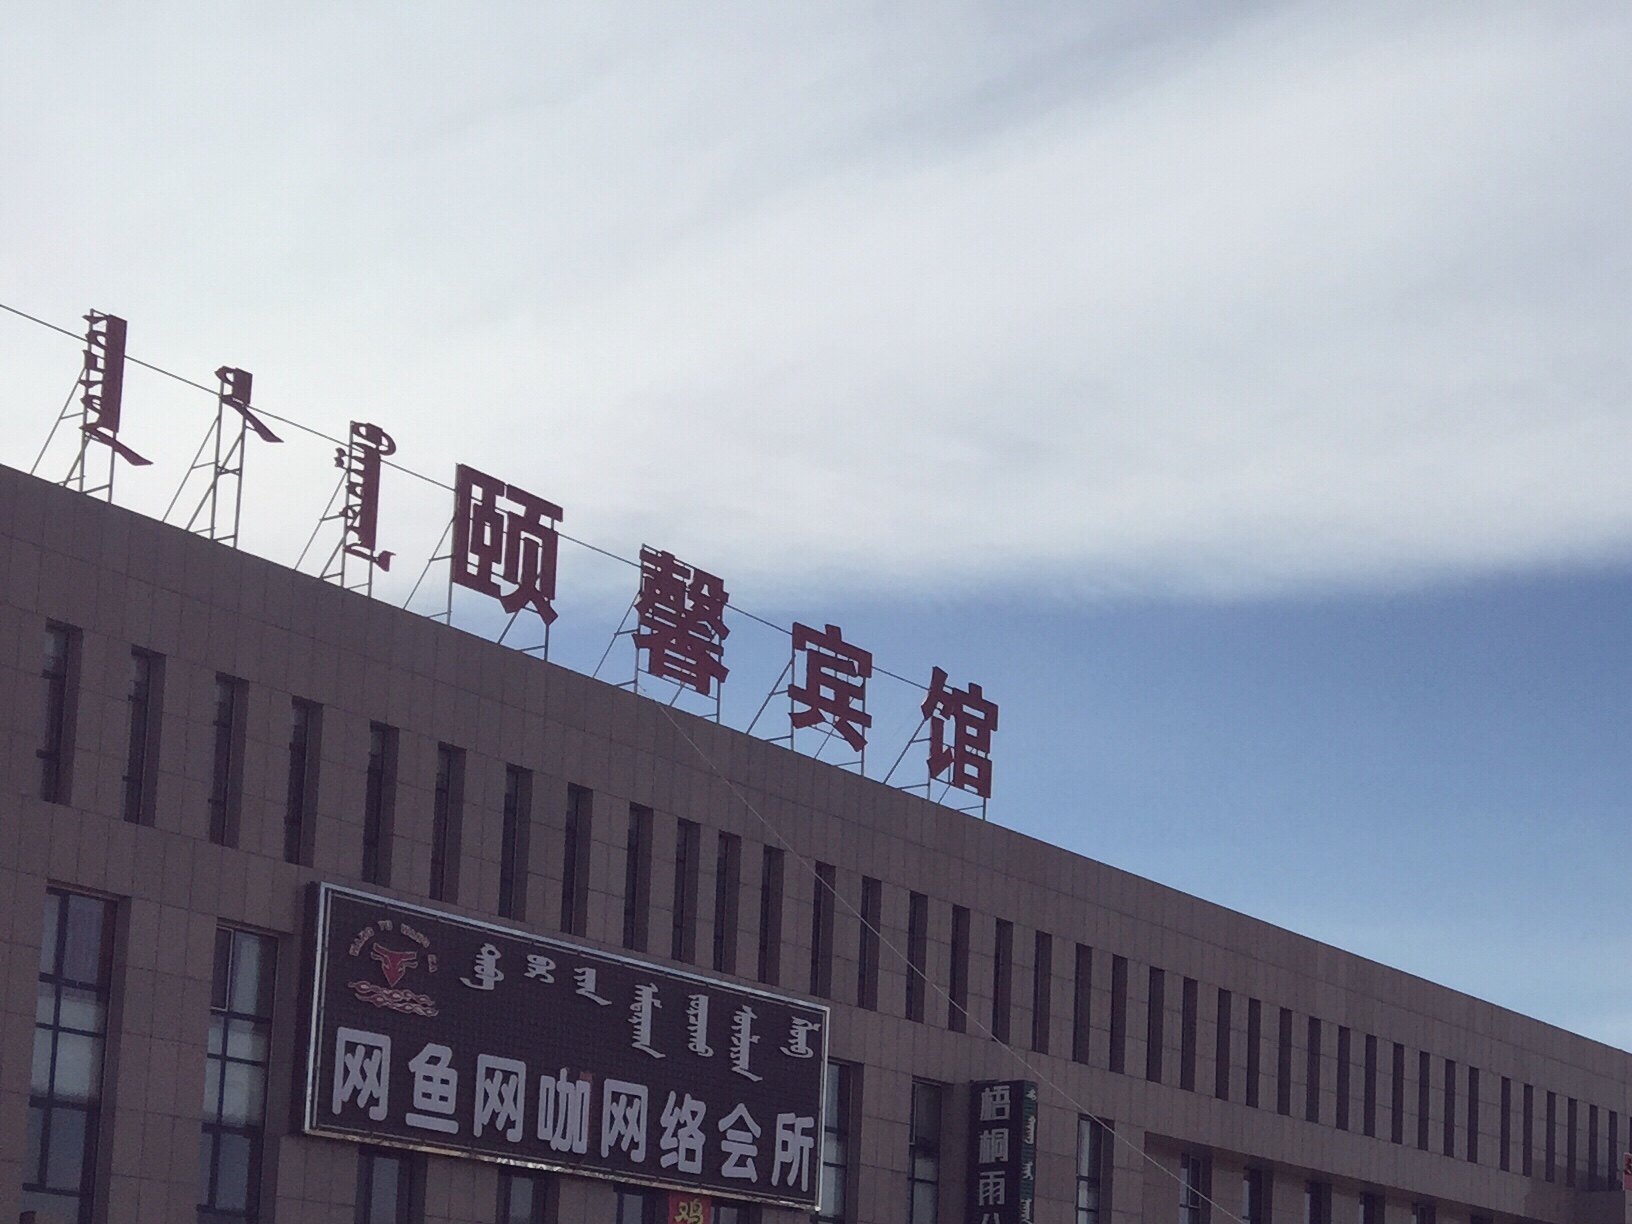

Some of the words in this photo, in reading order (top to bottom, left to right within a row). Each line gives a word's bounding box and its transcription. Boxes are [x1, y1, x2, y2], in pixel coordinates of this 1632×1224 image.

[454, 463, 999, 799] 颐馨宾馆
[332, 1026, 816, 1192] 网鱼网咖网络会所
